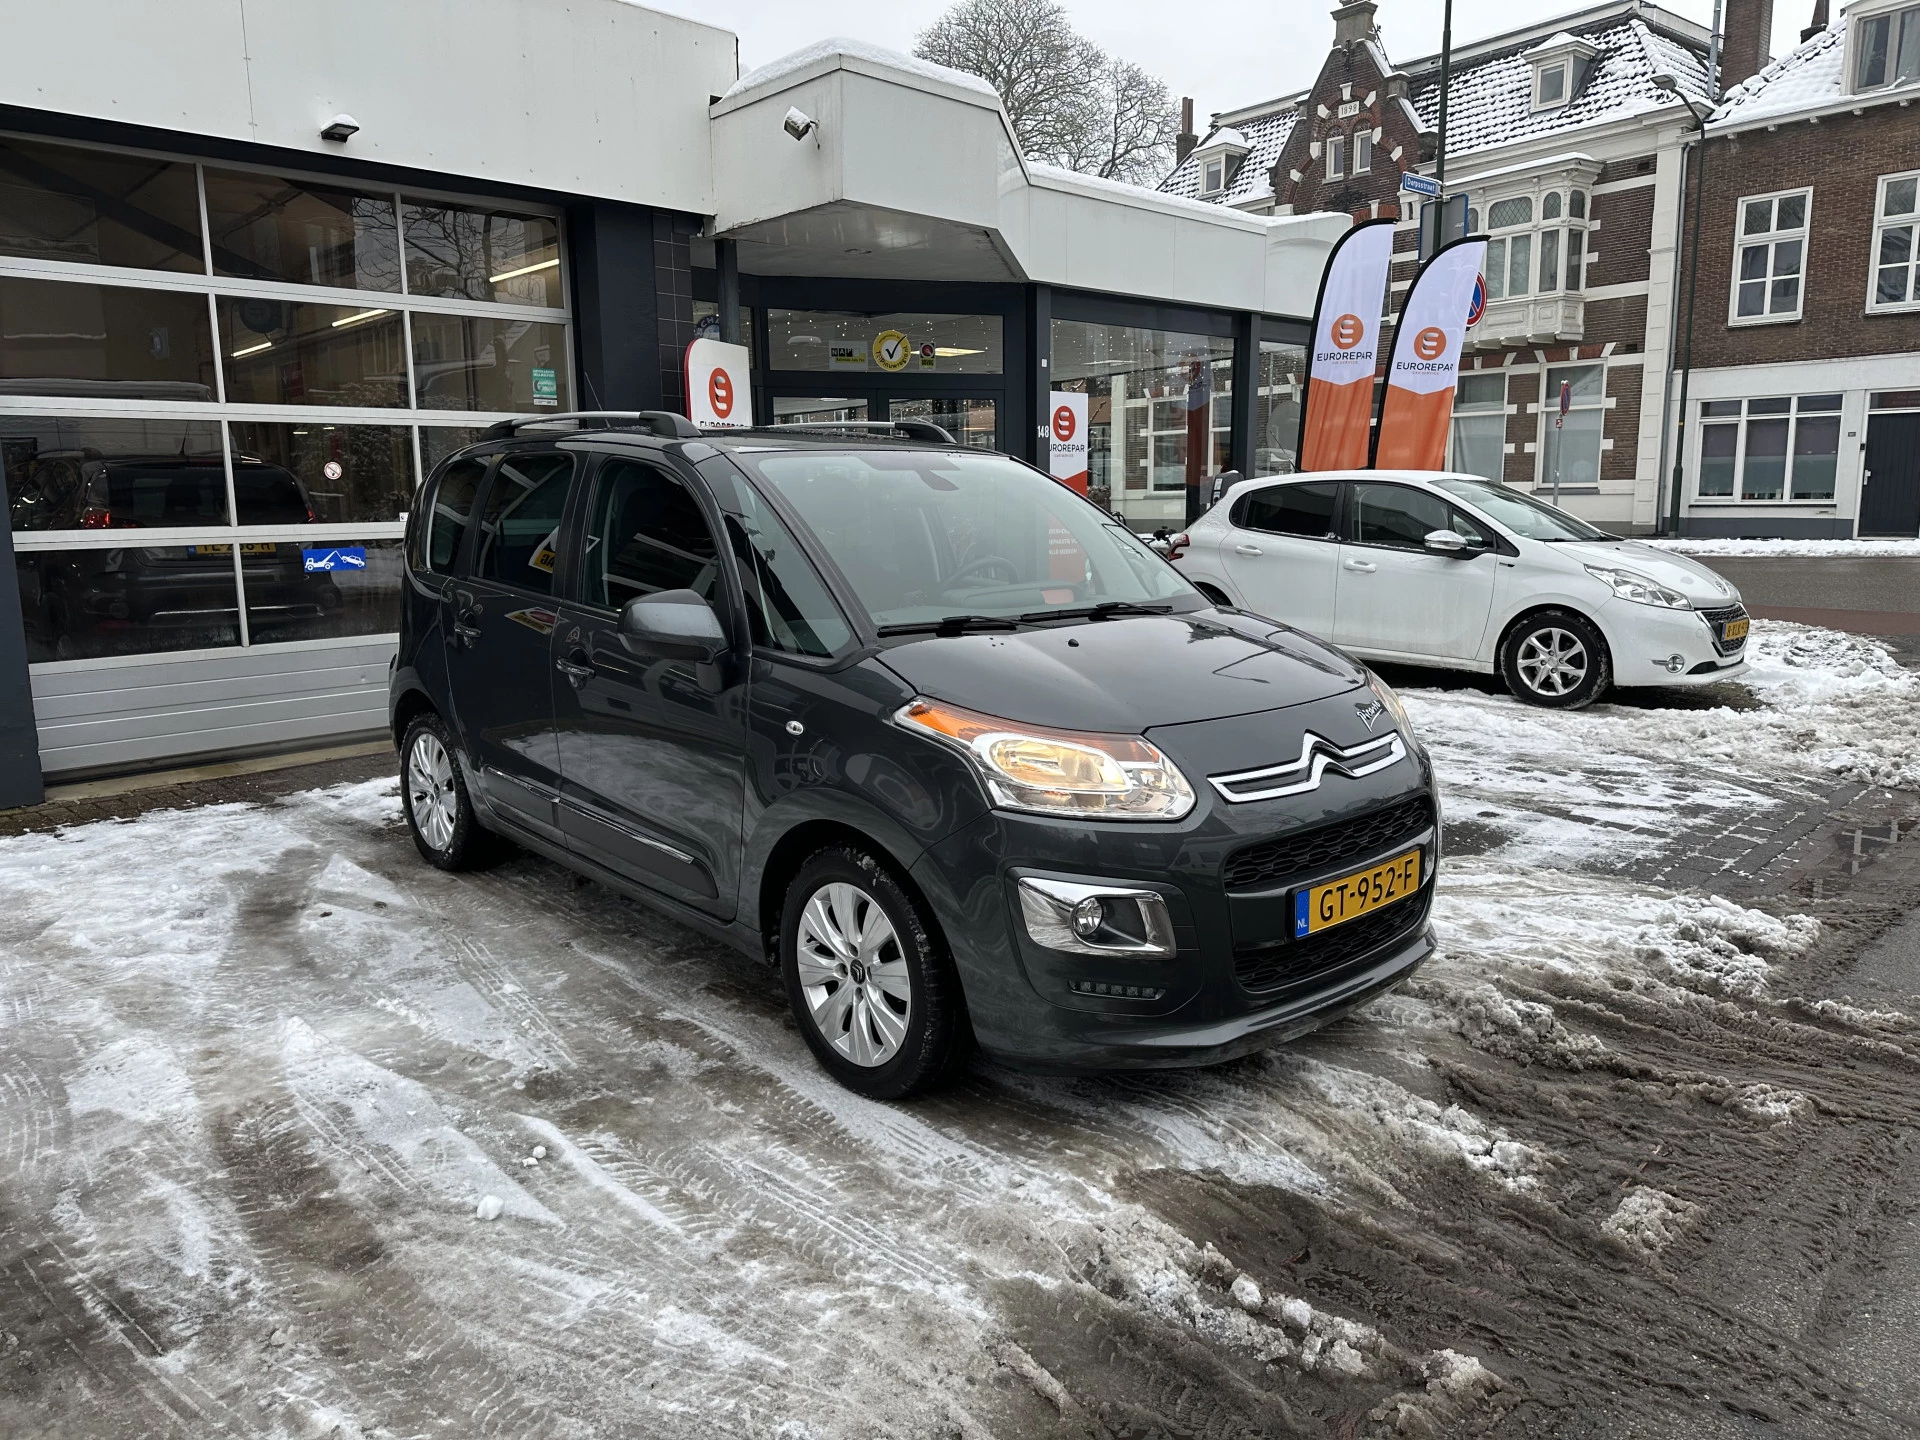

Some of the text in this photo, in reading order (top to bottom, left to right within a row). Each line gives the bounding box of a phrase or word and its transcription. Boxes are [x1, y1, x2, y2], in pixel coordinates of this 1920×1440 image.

[831, 347, 852, 356] NAP
[1317, 351, 1373, 362] EUROREPAR
[1037, 425, 1050, 438] 148
[1049, 443, 1085, 452] UROREPAR
[1320, 858, 1414, 922] GT-952-F
[1297, 918, 1308, 930] NL
